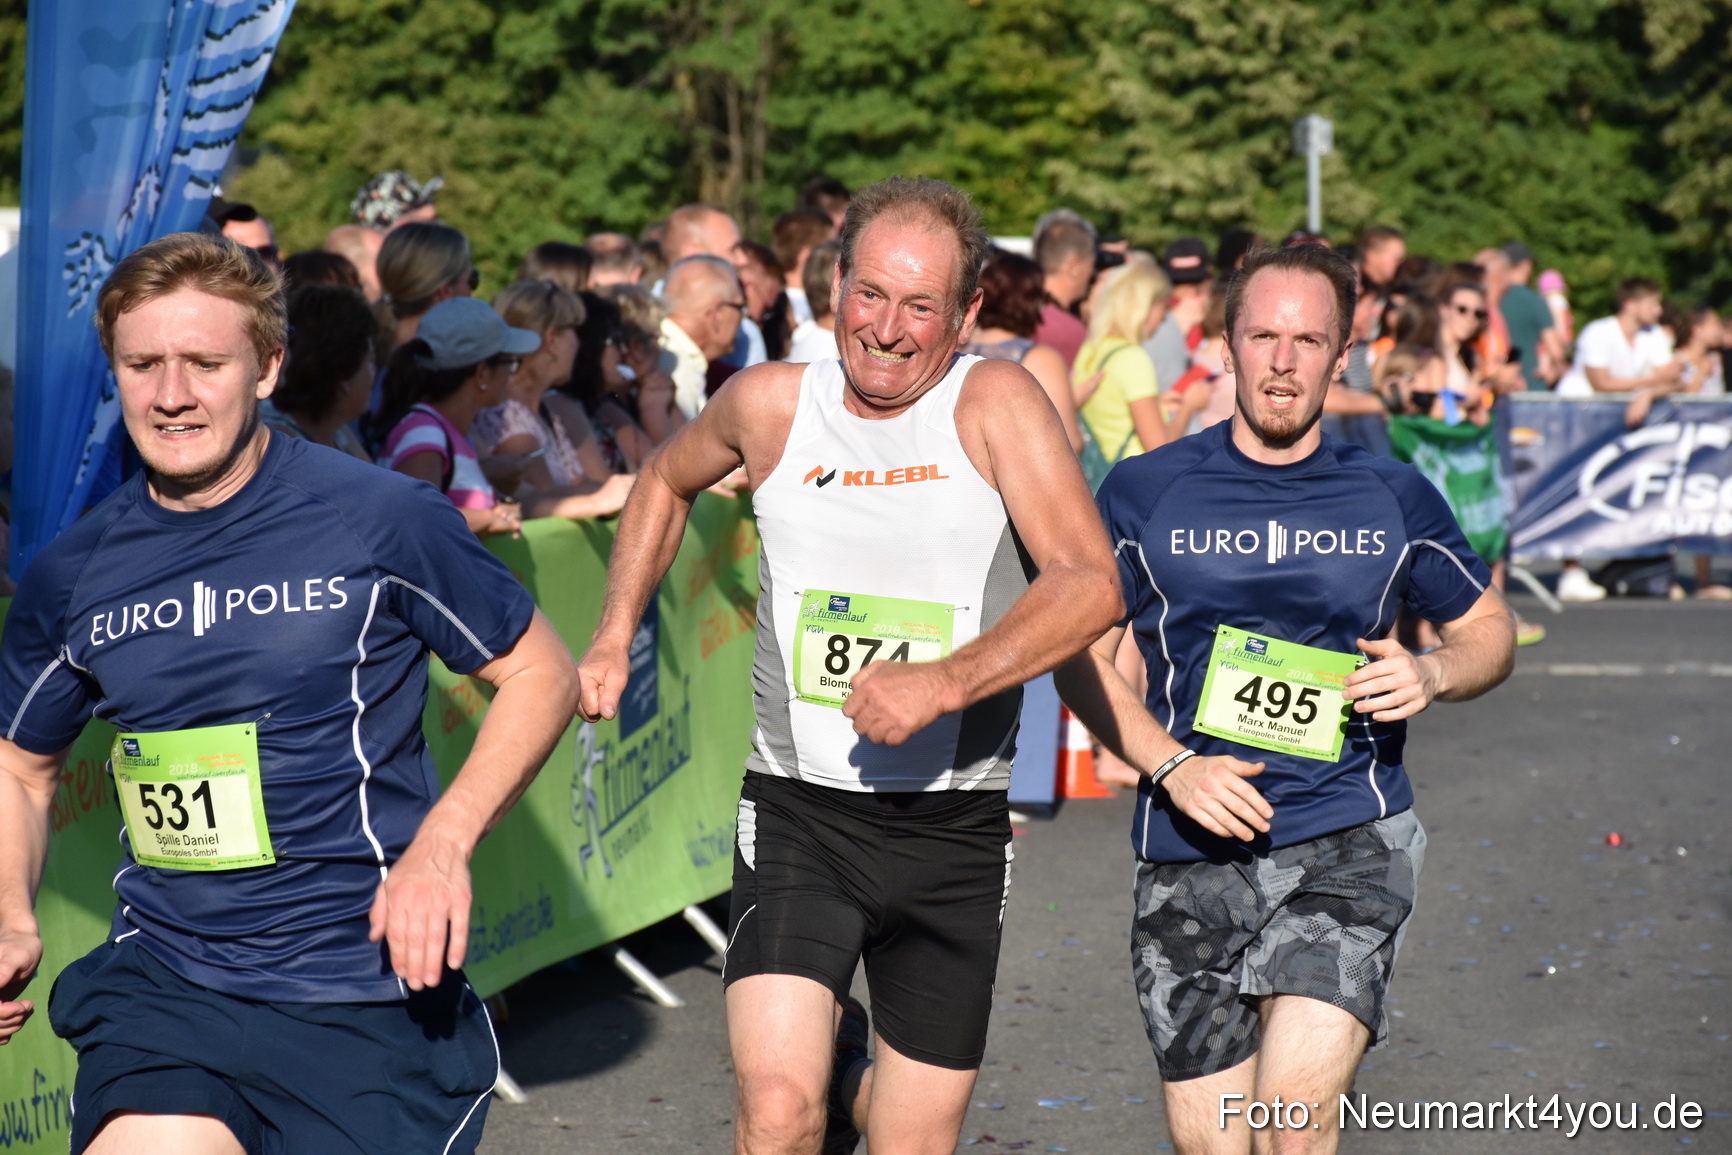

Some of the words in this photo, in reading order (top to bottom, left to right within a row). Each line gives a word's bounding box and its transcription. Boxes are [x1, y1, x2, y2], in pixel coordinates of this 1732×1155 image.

[843, 464, 949, 487] KLEBL
[1171, 529, 1259, 554] EURO
[1295, 529, 1386, 555] POLES
[90, 599, 182, 646] EURO
[226, 576, 348, 620] POLES
[818, 607, 867, 623] firmenlauf
[872, 623, 900, 634] 2018
[1233, 647, 1284, 667] firmenlauf
[1286, 669, 1313, 681] 2018
[1234, 675, 1321, 724] 495
[1237, 713, 1264, 728] Marx
[1267, 720, 1307, 737] Manuel
[1237, 725, 1275, 739] Europoles
[1278, 735, 1301, 745] GmbH
[168, 763, 199, 776] 2018
[139, 780, 217, 831] 531
[155, 833, 181, 847] Spille
[183, 833, 219, 846] Daniel
[161, 847, 192, 858] Europoles
[194, 848, 217, 857] GmbH
